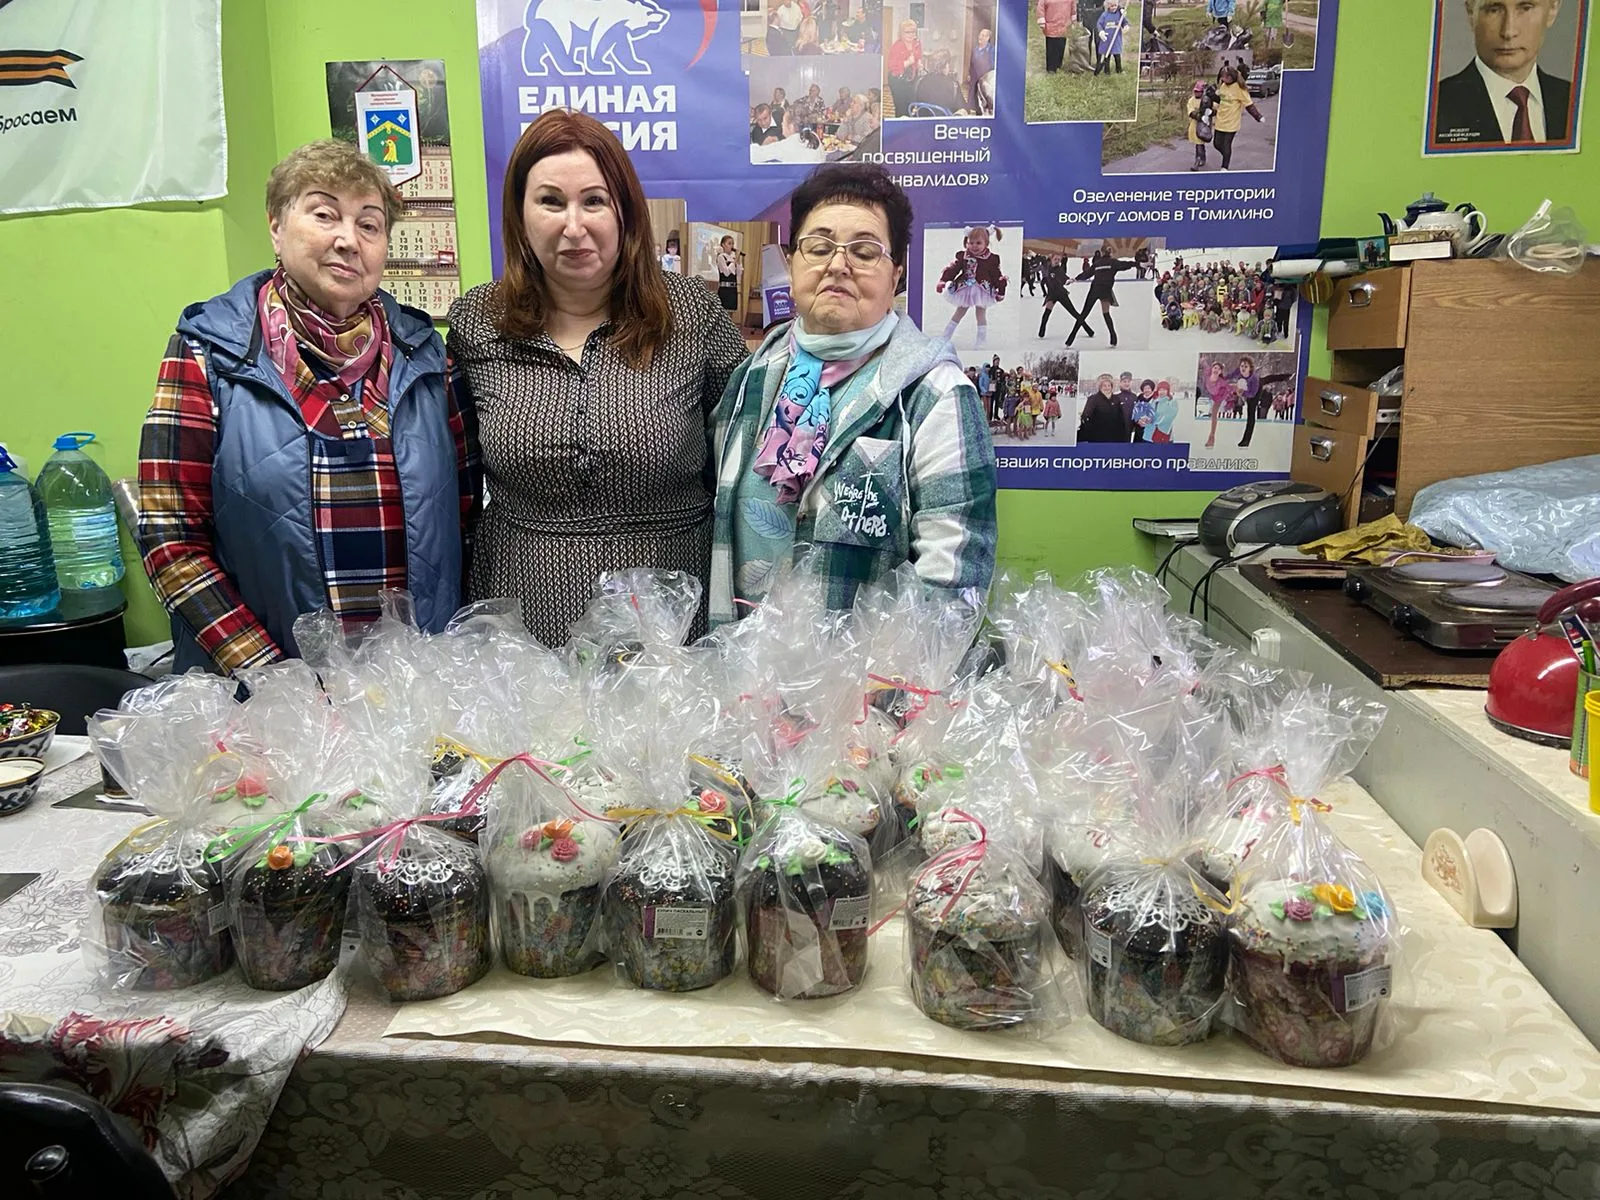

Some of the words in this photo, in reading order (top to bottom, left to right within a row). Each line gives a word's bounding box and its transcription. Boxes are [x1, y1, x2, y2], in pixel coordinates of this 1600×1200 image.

[518, 85, 676, 114] ЕДИНАЯ
[934, 124, 991, 142] Вечер
[862, 147, 991, 165] посвященный
[889, 173, 988, 188] нвалидов»
[1073, 189, 1173, 204] Озеленение
[1176, 188, 1275, 203] территории
[1058, 211, 1115, 225] вокруг
[1117, 209, 1170, 223] домов
[1174, 209, 1184, 221] в
[1187, 206, 1274, 221] Томилино
[1053, 457, 1162, 471] спортивного
[1166, 457, 1259, 471] праздника
